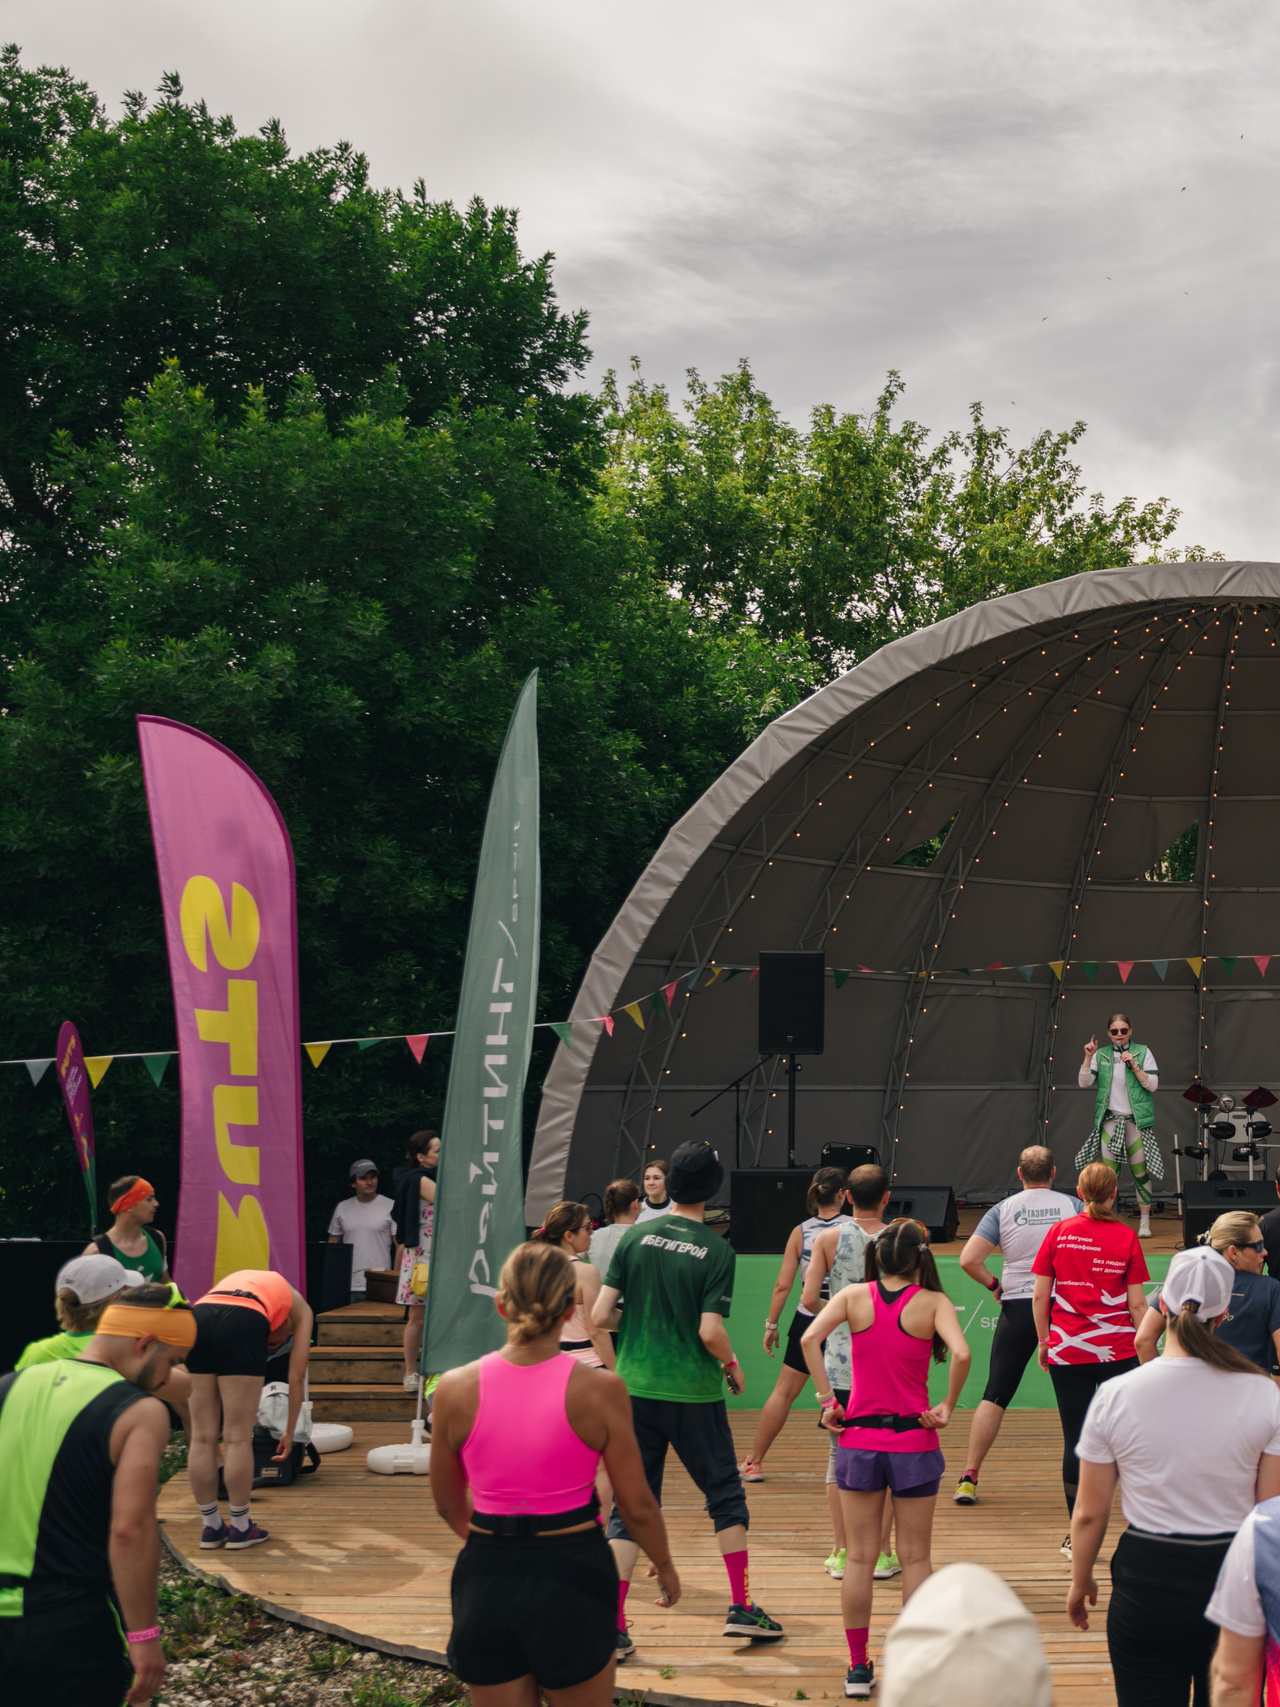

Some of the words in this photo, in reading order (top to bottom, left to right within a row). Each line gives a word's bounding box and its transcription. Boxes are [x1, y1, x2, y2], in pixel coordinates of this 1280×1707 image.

[1027, 1208, 1061, 1218] ГАЗПРОМ
[1068, 1234, 1093, 1243] бегунов
[641, 1234, 709, 1260] #БЕГИГЕРОЙ
[1067, 1243, 1102, 1252] марафонов
